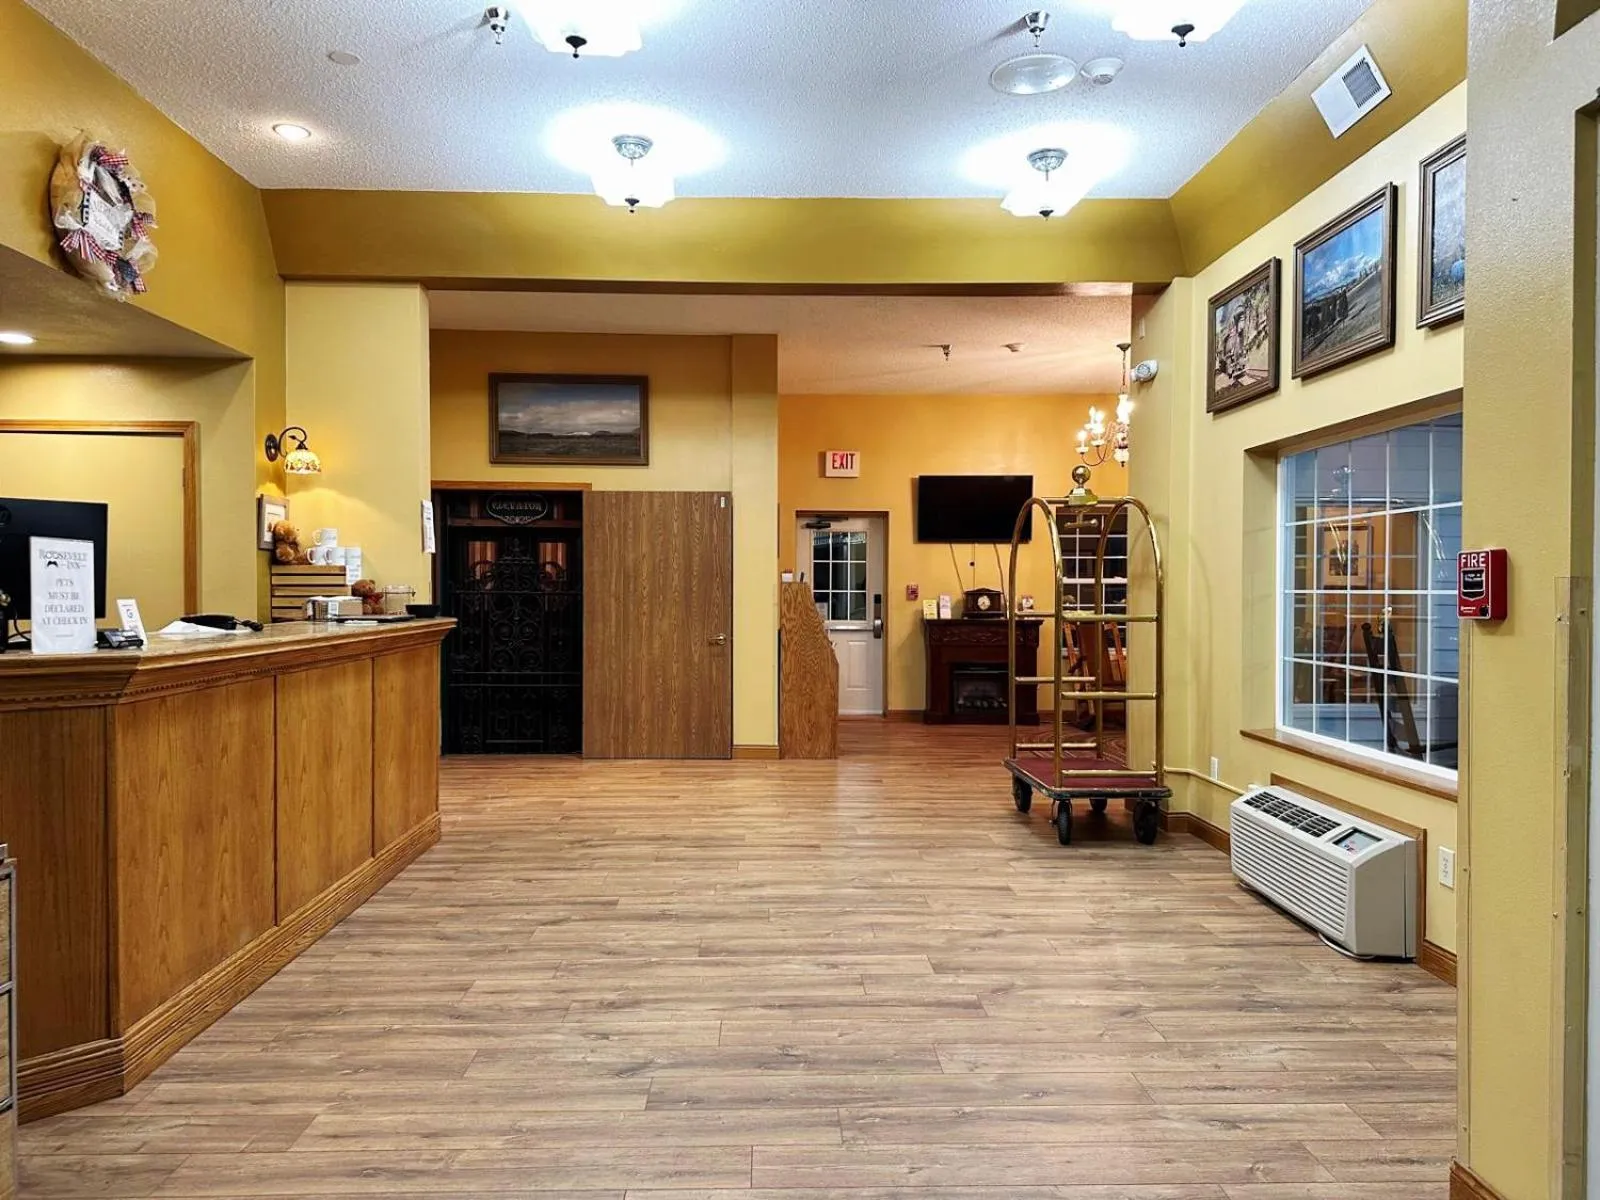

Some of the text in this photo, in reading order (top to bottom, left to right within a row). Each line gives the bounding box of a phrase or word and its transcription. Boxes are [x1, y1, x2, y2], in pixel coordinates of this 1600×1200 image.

[832, 453, 855, 470] EXIT
[1461, 553, 1486, 567] FIRE
[55, 578, 74, 587] PETS
[48, 591, 68, 600] MUST
[44, 604, 84, 613] DECLARED
[42, 616, 50, 625] AT
[53, 616, 78, 625] CHECK
